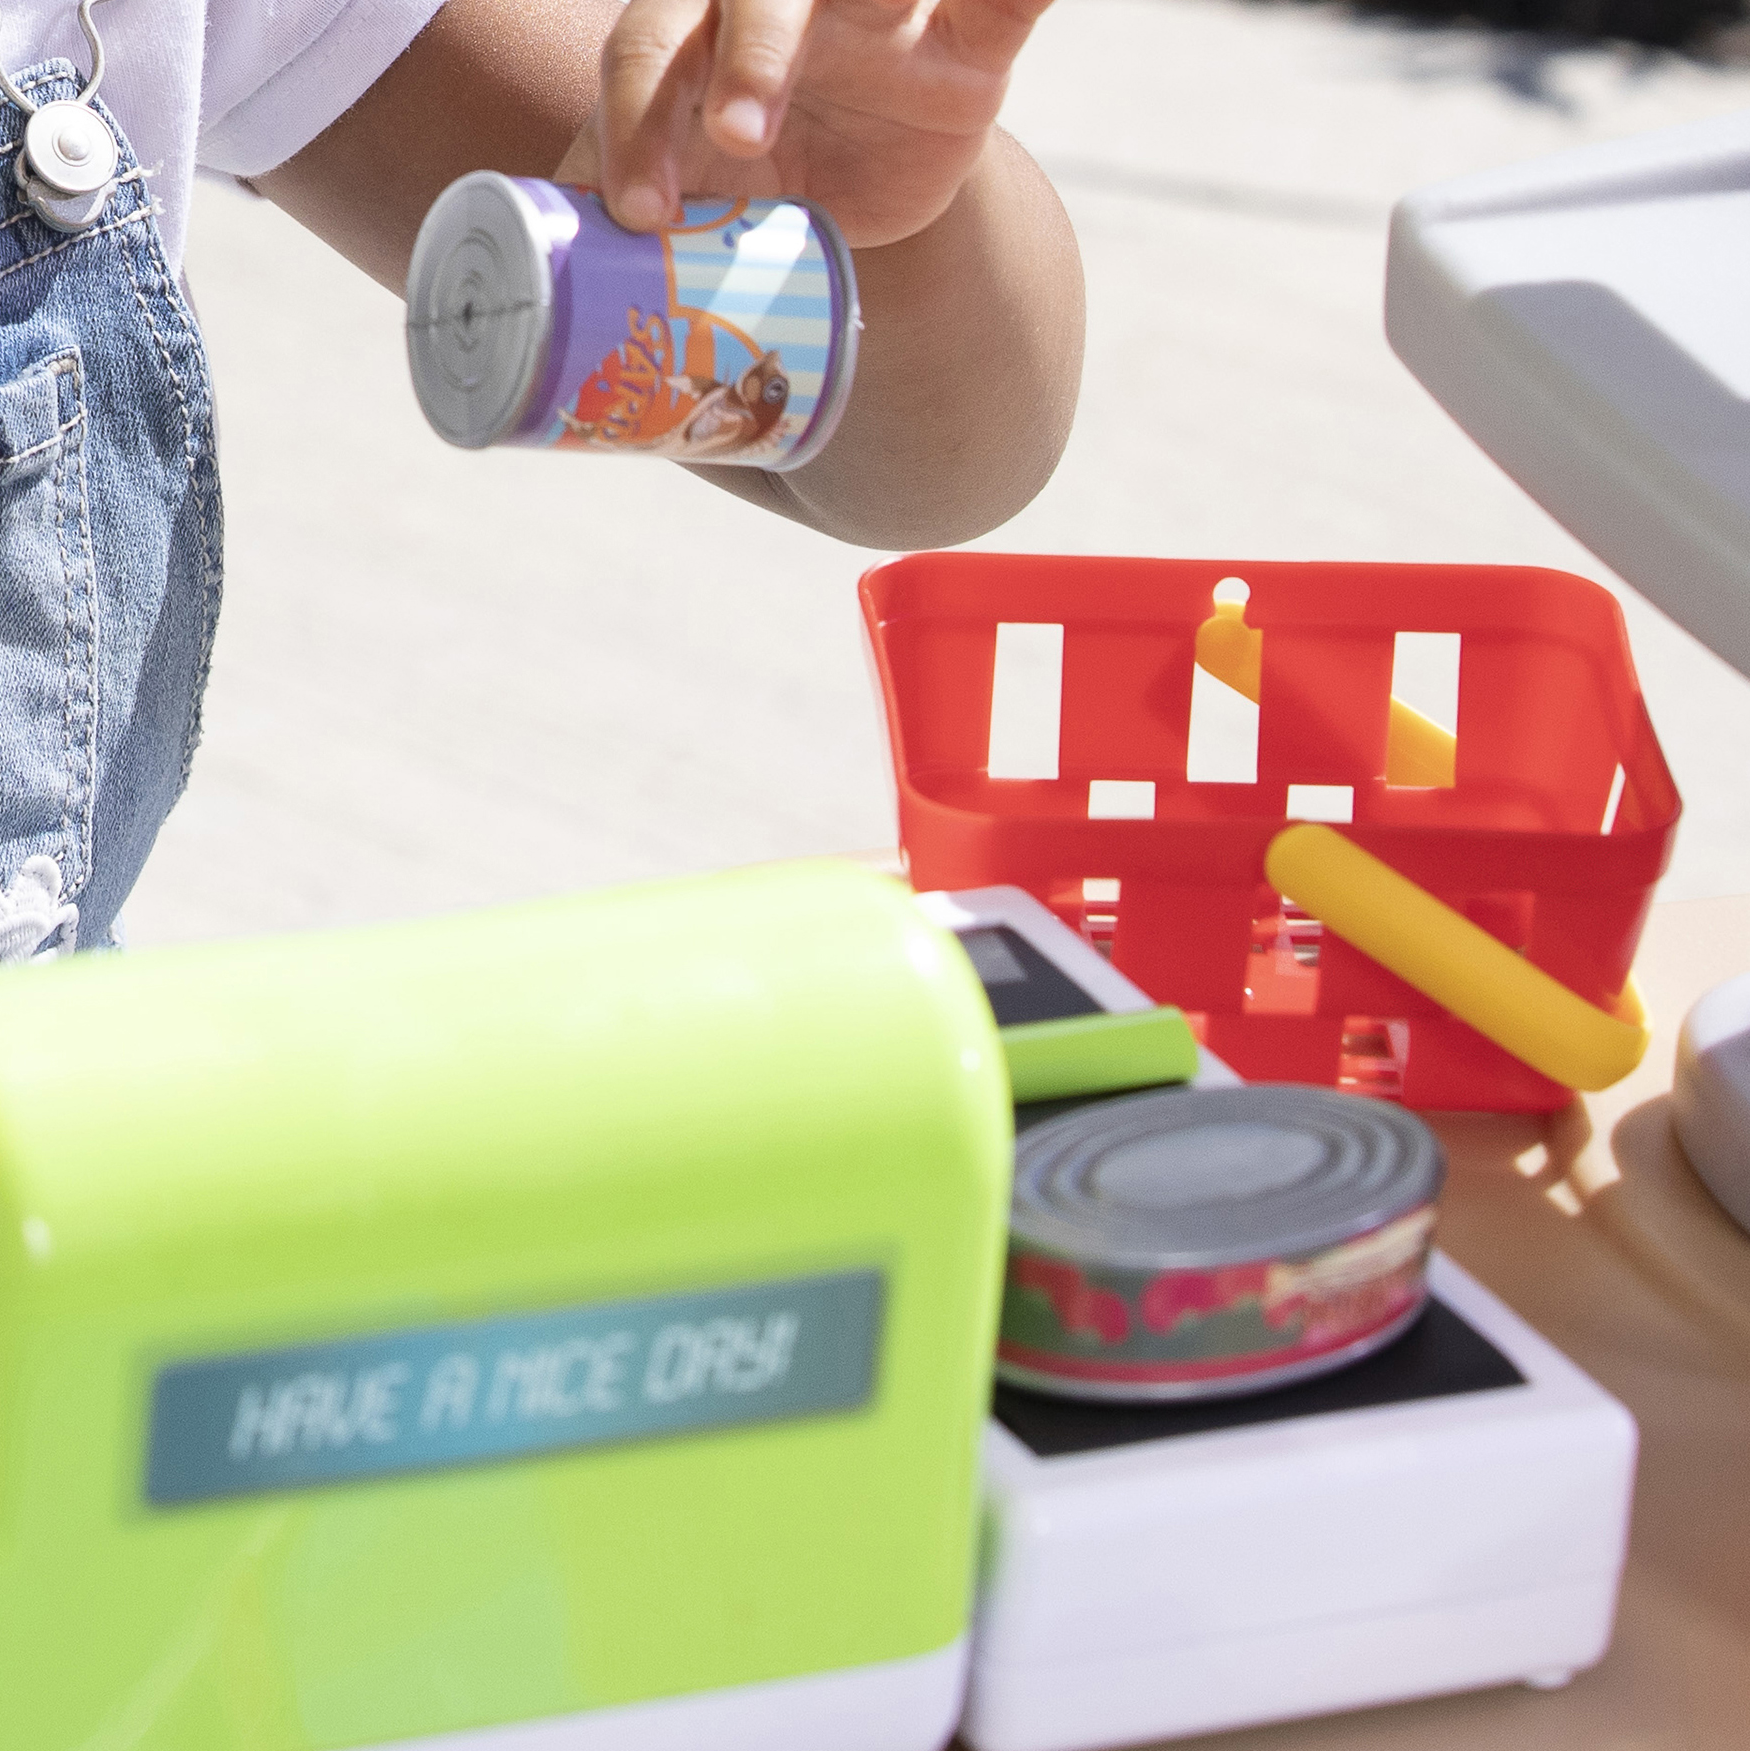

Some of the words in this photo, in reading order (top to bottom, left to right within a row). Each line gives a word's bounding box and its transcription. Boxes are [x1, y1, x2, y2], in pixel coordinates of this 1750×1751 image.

[228, 1362, 412, 1461] HAVE
[419, 1352, 480, 1430] A
[486, 1332, 638, 1422] NICE
[643, 1311, 802, 1406] DAY!
